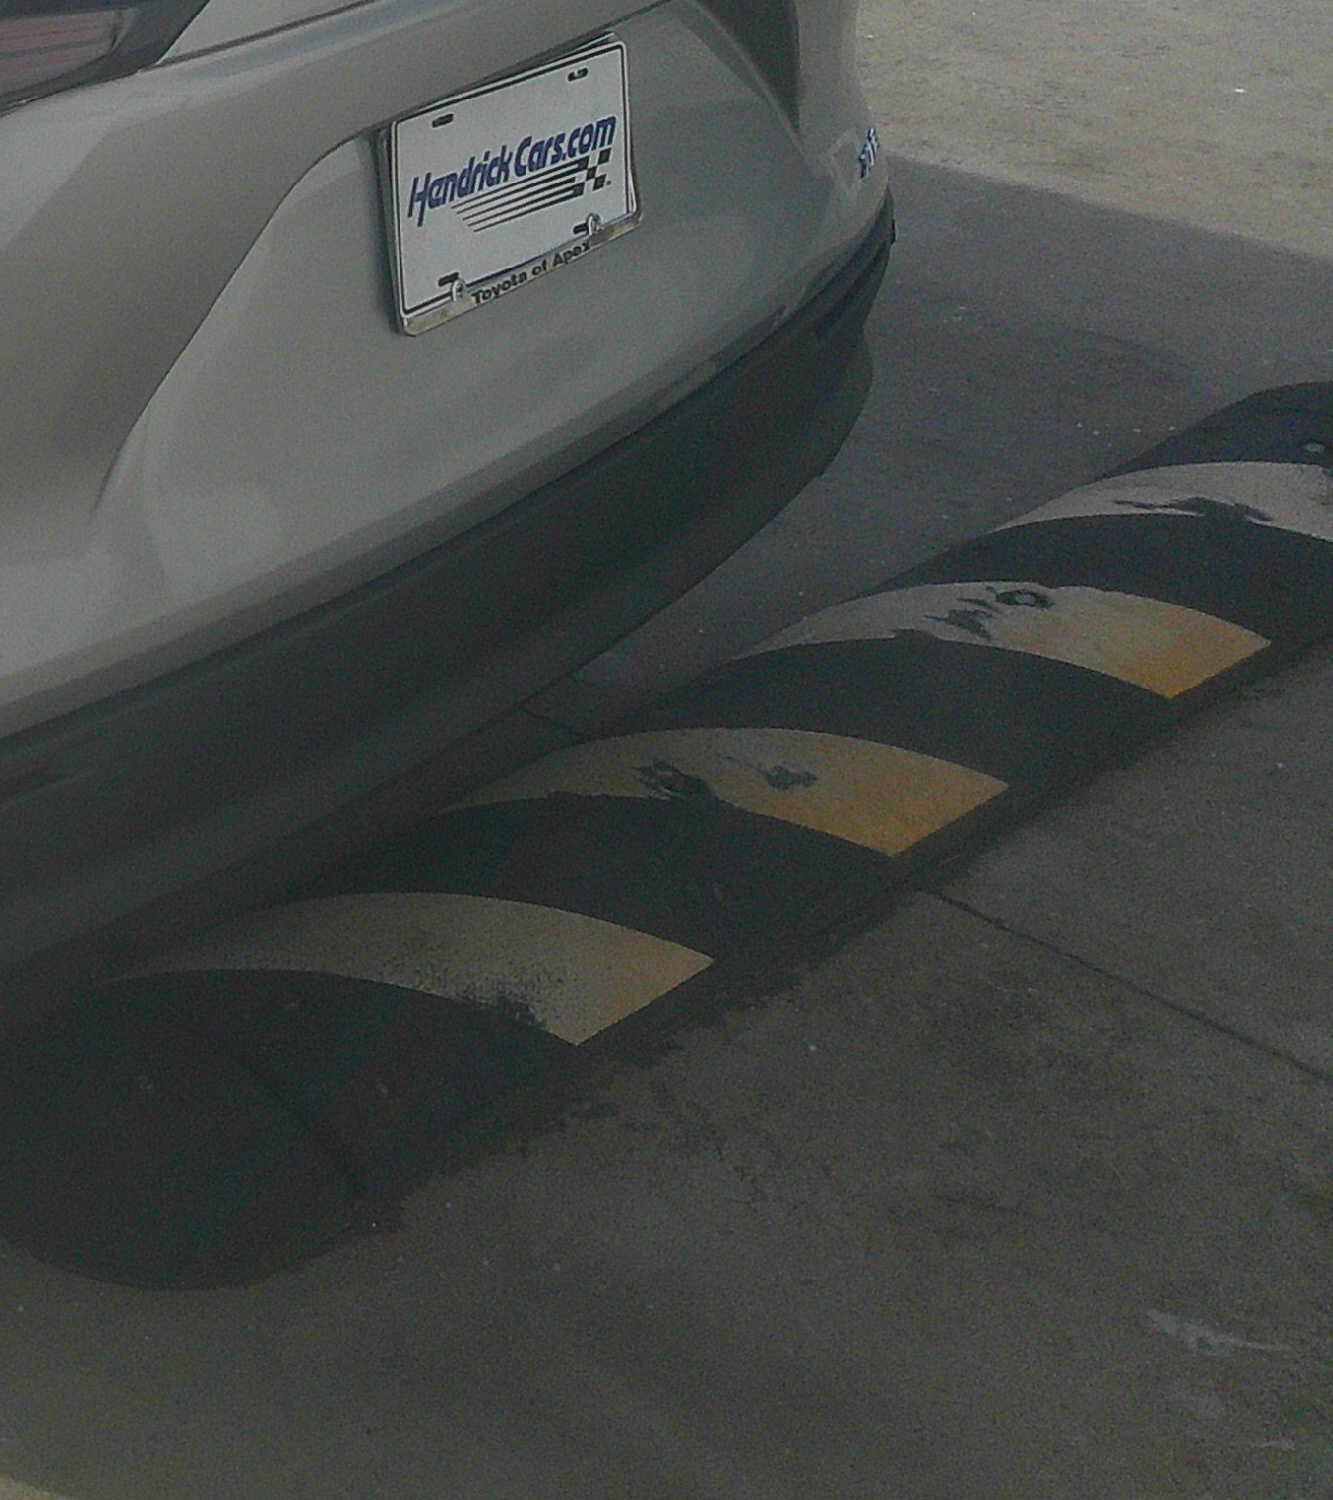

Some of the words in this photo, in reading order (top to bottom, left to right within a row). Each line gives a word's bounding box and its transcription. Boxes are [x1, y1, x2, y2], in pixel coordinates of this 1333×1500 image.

[471, 273, 528, 304] Toyota
[531, 259, 547, 275] of
[552, 240, 591, 268] Apex
